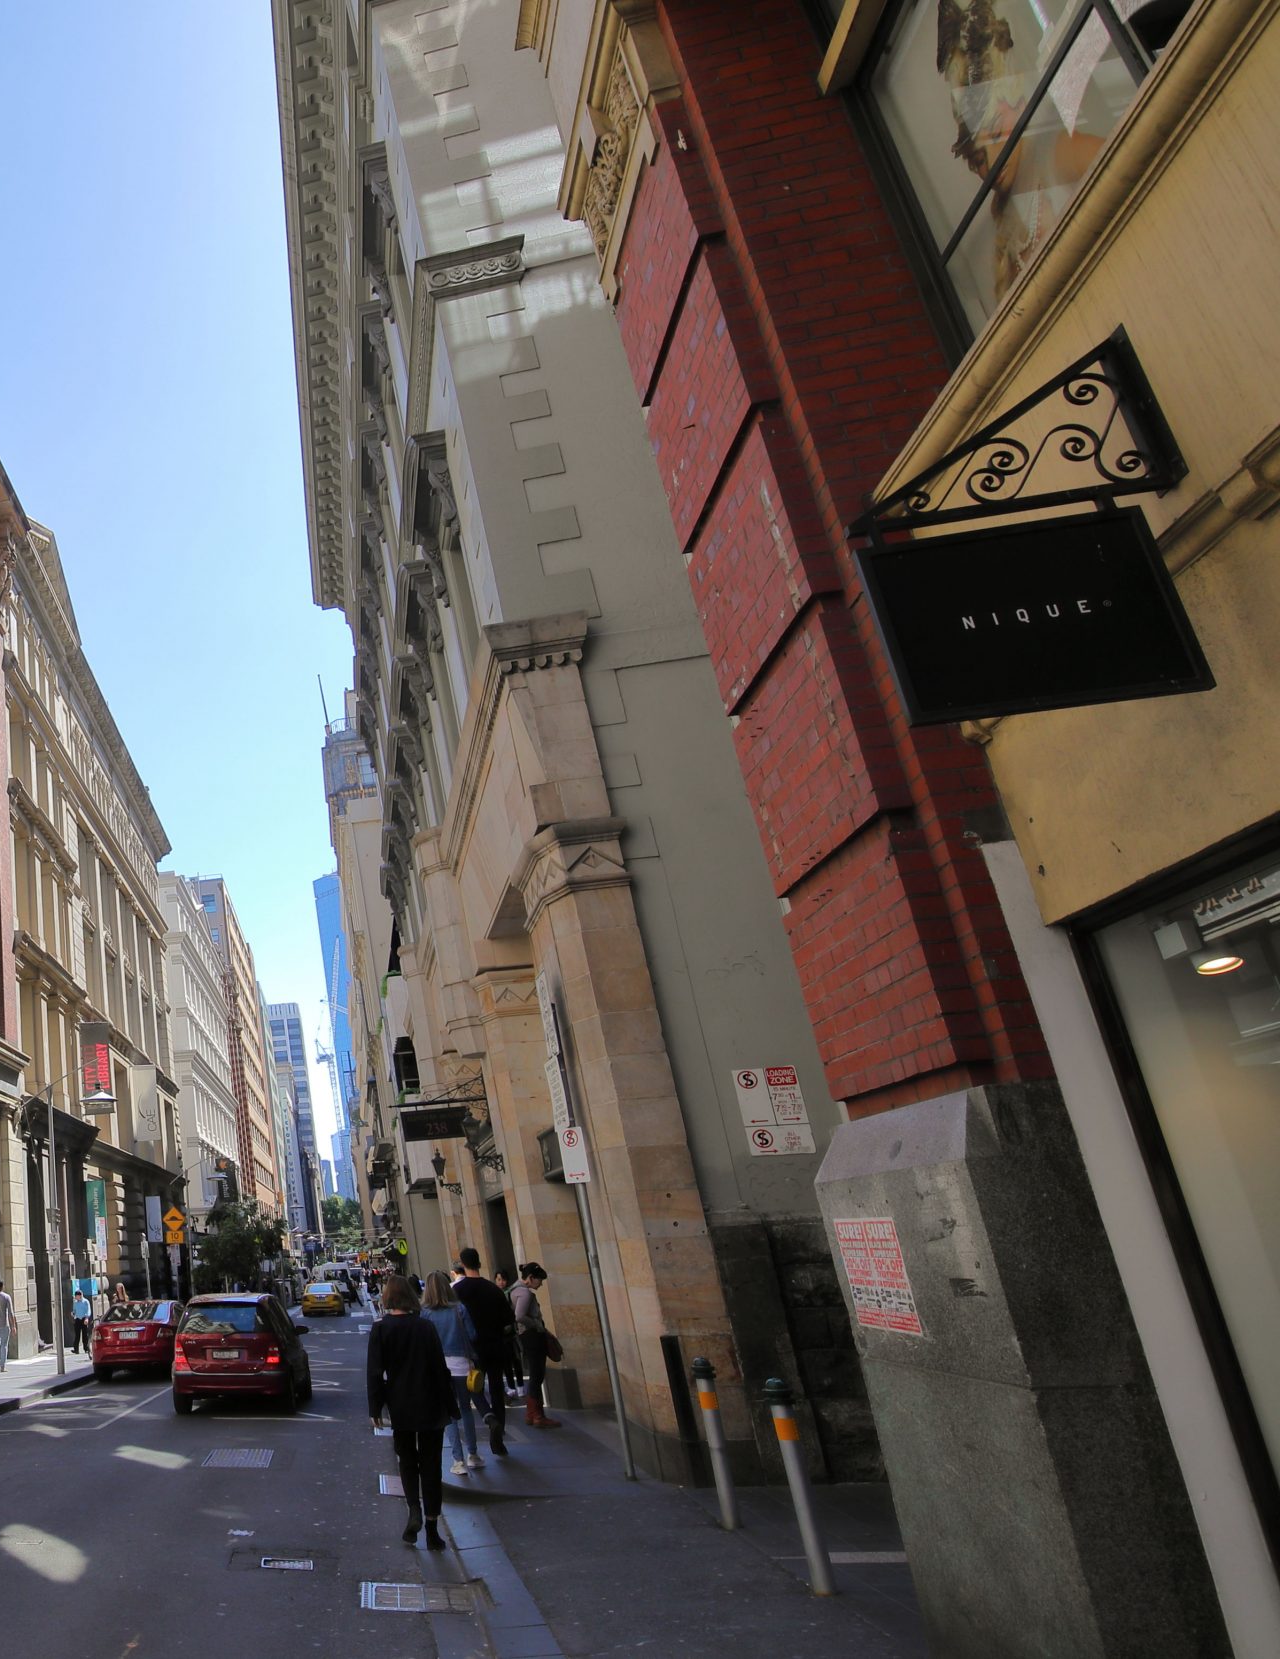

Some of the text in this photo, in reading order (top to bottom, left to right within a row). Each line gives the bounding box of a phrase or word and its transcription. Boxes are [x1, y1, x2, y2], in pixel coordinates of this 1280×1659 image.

[961, 599, 1092, 630] NIQUE
[95, 1043, 111, 1089] LIBRARY
[766, 1068, 795, 1077] LOADING
[84, 1066, 96, 1091] CITY
[770, 1076, 795, 1085] ZONE
[146, 1108, 158, 1132] CAE
[425, 1121, 448, 1136] 238
[171, 1232, 180, 1240] 10
[837, 1223, 864, 1239] SURE!
[865, 1222, 895, 1239] SURE!
[890, 1259, 904, 1271] OFF
